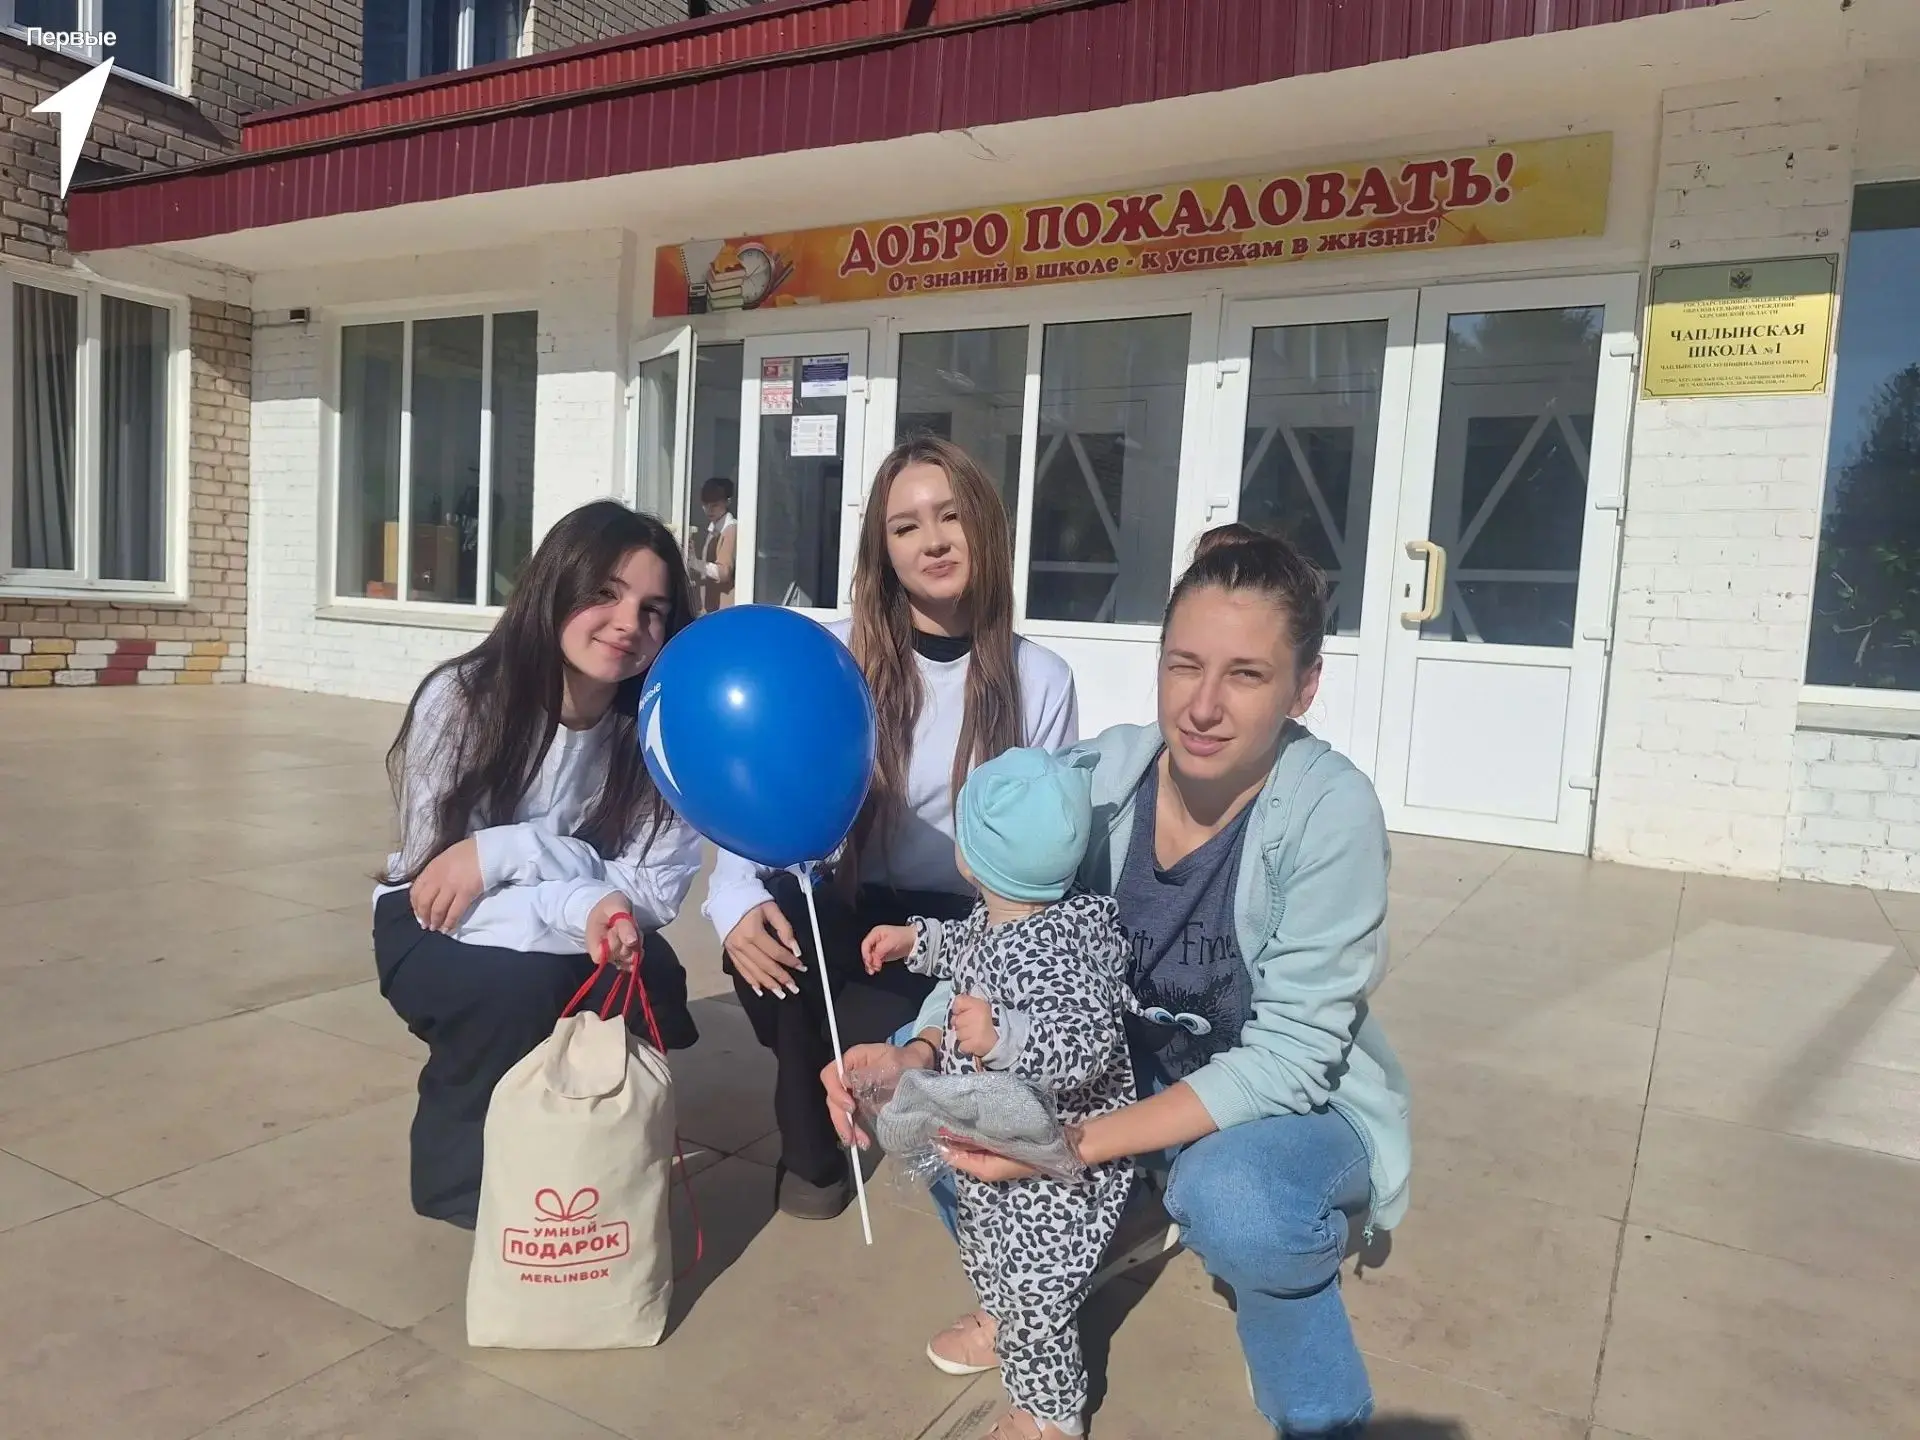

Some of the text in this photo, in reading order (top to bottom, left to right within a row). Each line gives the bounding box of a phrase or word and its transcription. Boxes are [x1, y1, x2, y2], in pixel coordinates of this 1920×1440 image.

[838, 152, 1514, 277] ДОБРО ПОЖАЛОВАТЬ!
[888, 272, 917, 292] От
[923, 262, 1008, 289] знаний
[1014, 265, 1029, 282] в
[1035, 257, 1119, 279] школе
[1140, 252, 1160, 270] к
[1165, 238, 1284, 273] успехам
[1291, 238, 1309, 255] в
[1316, 217, 1440, 252] жизни!
[1670, 323, 1805, 342] ЧАПЛЫНСКАЯ
[1688, 344, 1757, 358] ШКОЛА
[533, 1221, 598, 1238] УМНЫЙ
[511, 1232, 620, 1260] ПОДАРОК
[520, 1268, 610, 1284] MERLINBOX
